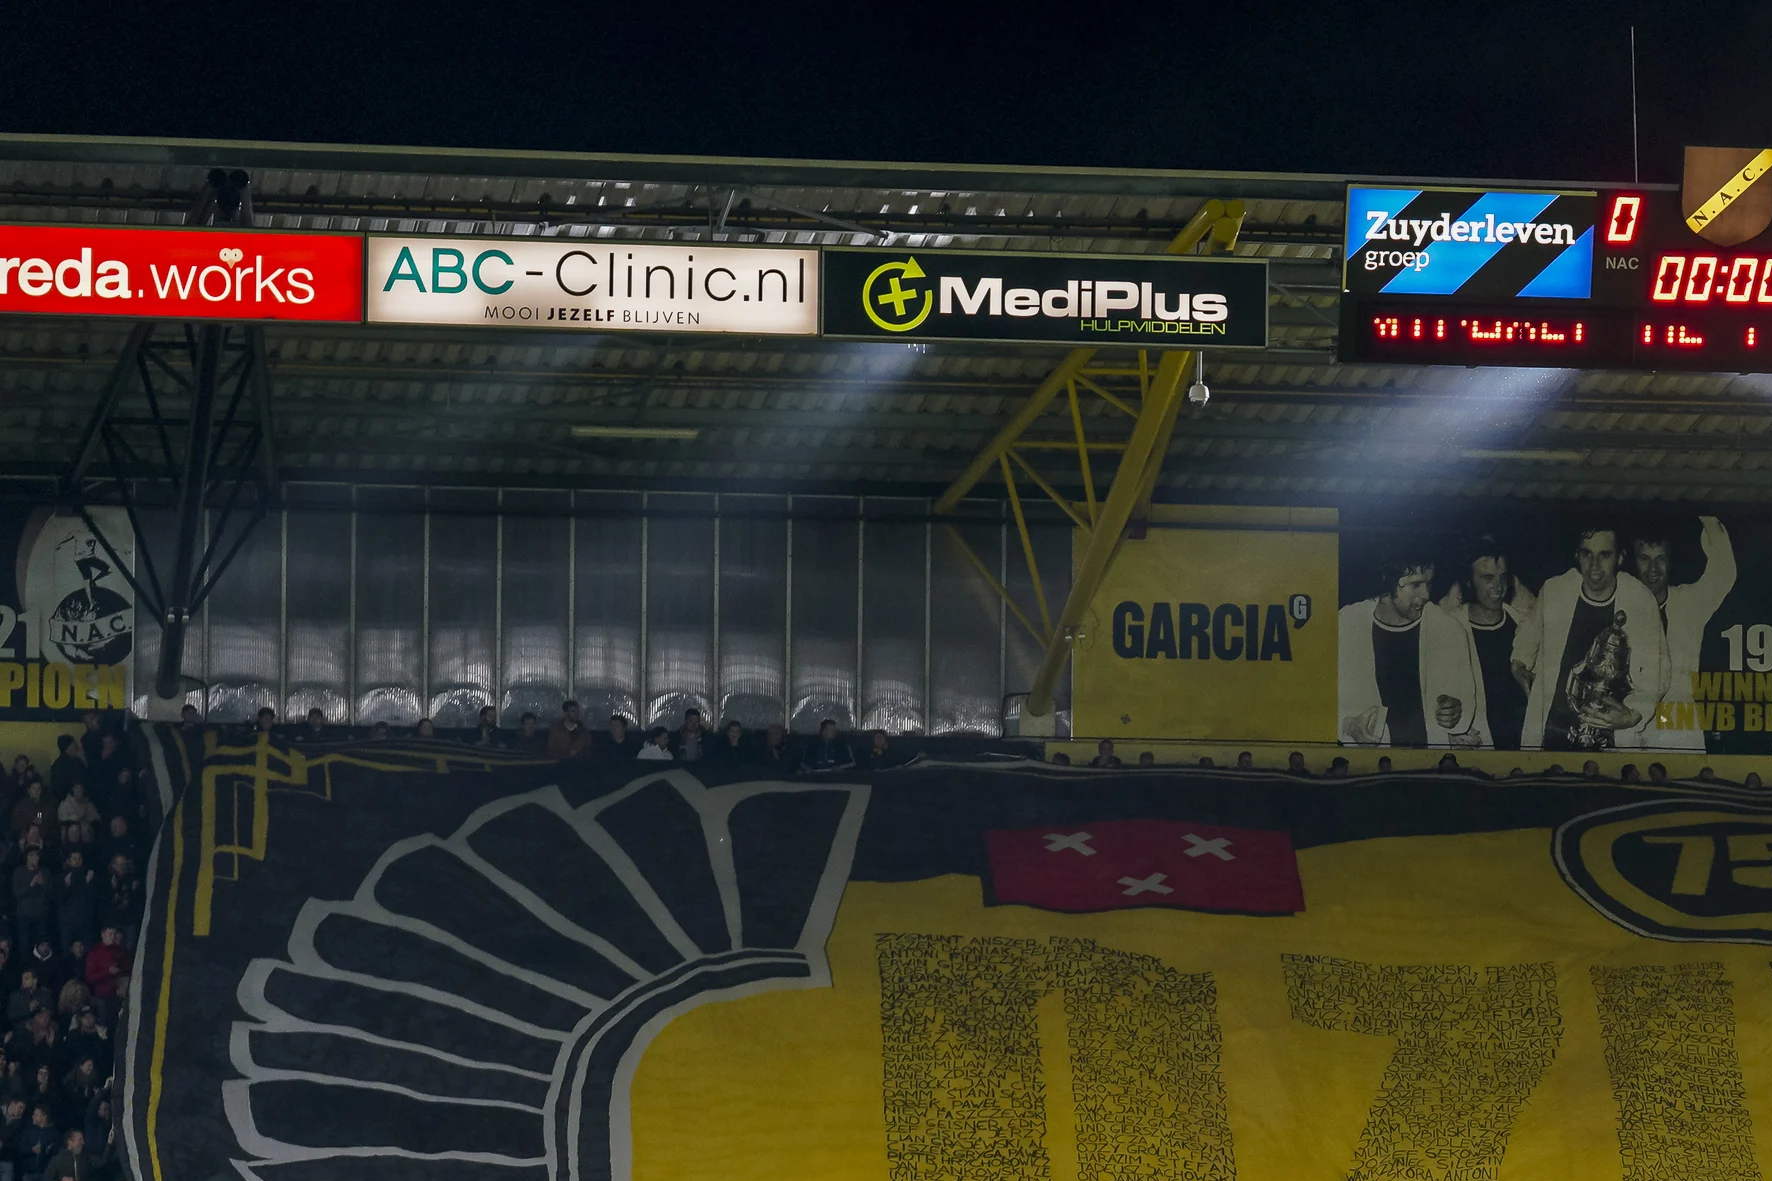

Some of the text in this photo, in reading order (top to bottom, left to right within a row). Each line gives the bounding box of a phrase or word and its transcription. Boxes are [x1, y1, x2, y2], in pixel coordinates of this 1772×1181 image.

[1692, 167, 1763, 227] N.A.C.
[1365, 210, 1576, 247] Zuyderleven
[1607, 196, 1640, 242] 0
[1365, 250, 1431, 273] groep
[1605, 257, 1640, 270] NAC
[939, 276, 1229, 322] MediPlus
[484, 304, 702, 326] MOOI JEZELF BLIJVEN
[1080, 319, 1227, 336] HULPMIDDELEN
[61, 614, 133, 643] N.A.C.
[1112, 601, 1293, 661] GARCIA
[1656, 702, 1735, 732] KNVB
